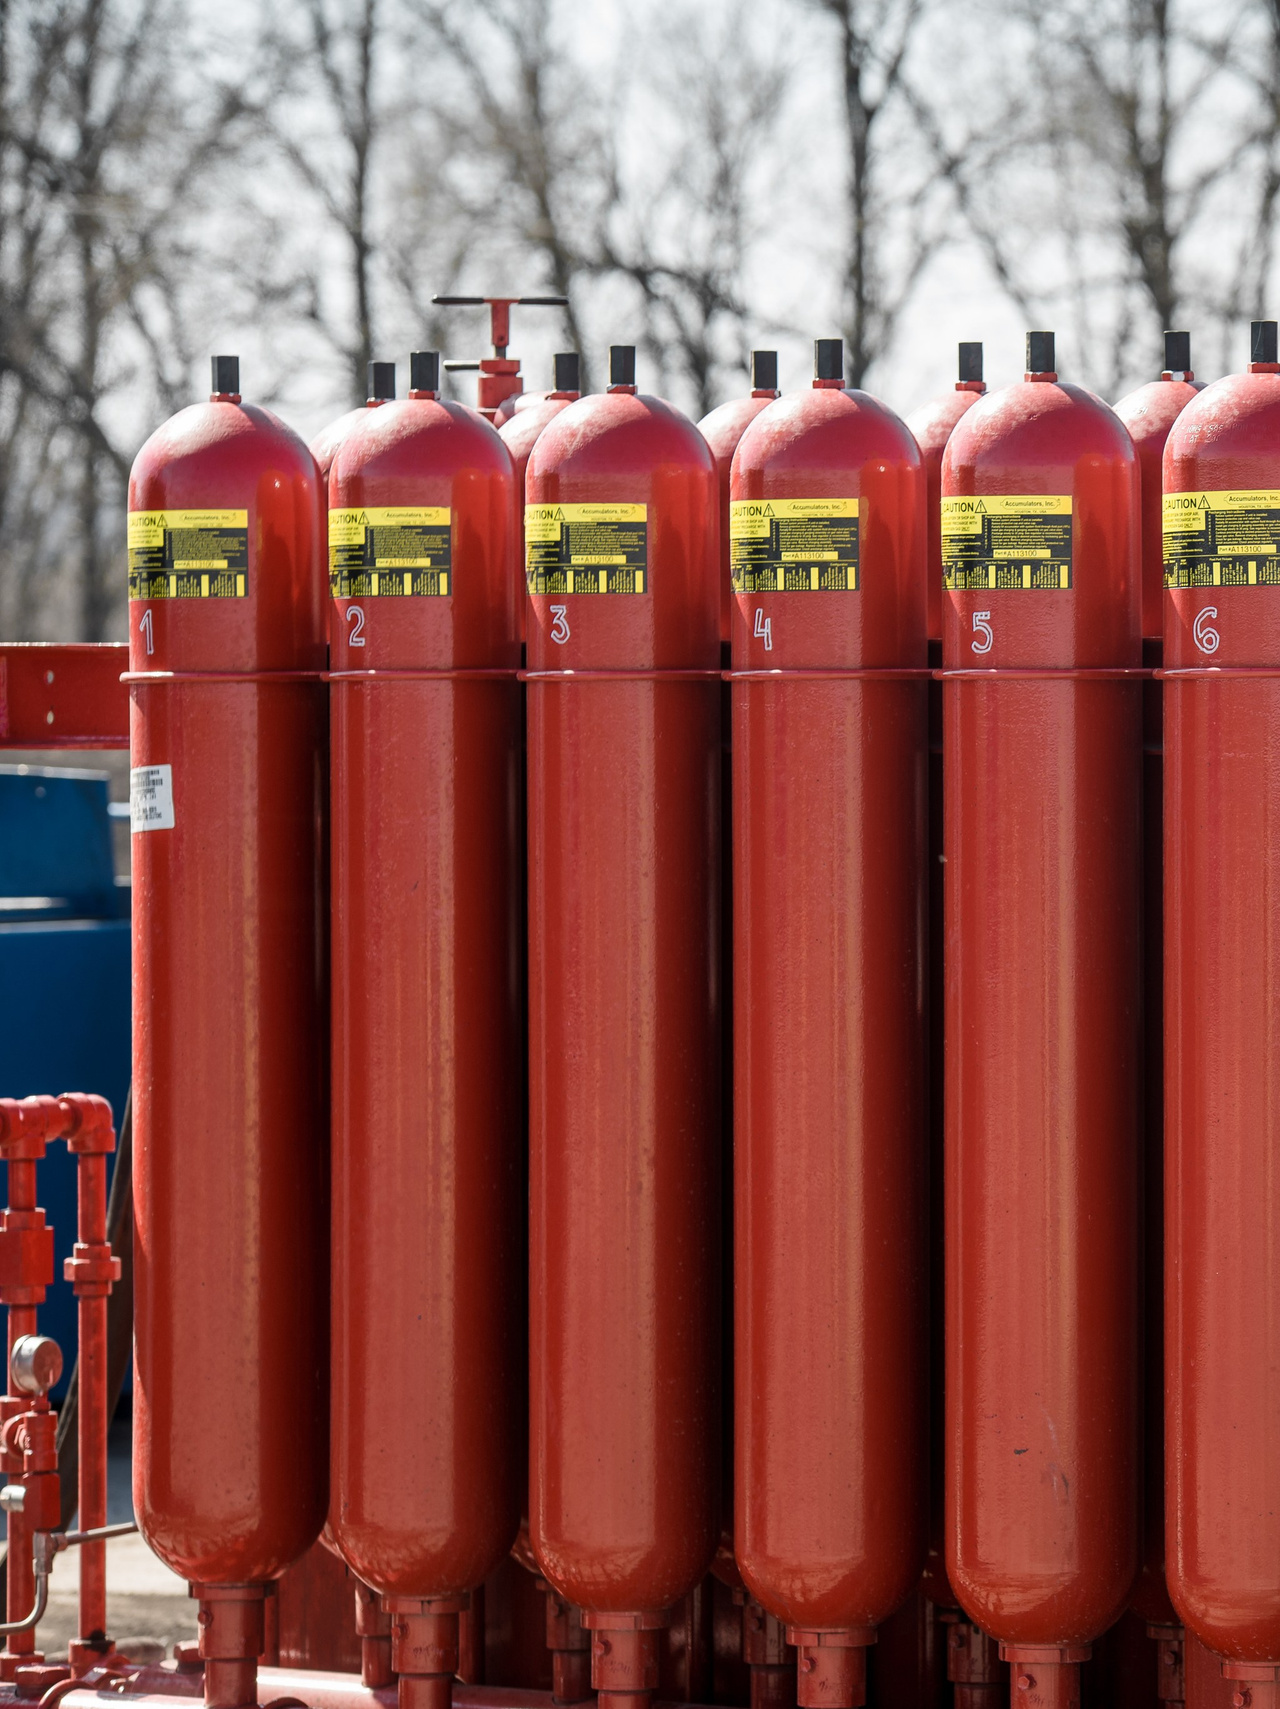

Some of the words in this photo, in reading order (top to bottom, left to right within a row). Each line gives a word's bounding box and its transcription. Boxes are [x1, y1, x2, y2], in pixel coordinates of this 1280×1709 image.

[131, 517, 156, 527] UTION
[332, 514, 357, 524] UTION
[529, 510, 553, 520] UTION
[733, 506, 762, 516] AUTION
[944, 502, 974, 512] AUTION
[139, 608, 154, 655] 1
[346, 605, 365, 647] 2
[550, 605, 570, 644] 3
[754, 607, 773, 651] 4
[971, 610, 994, 654] 5
[1193, 606, 1220, 654] 6
